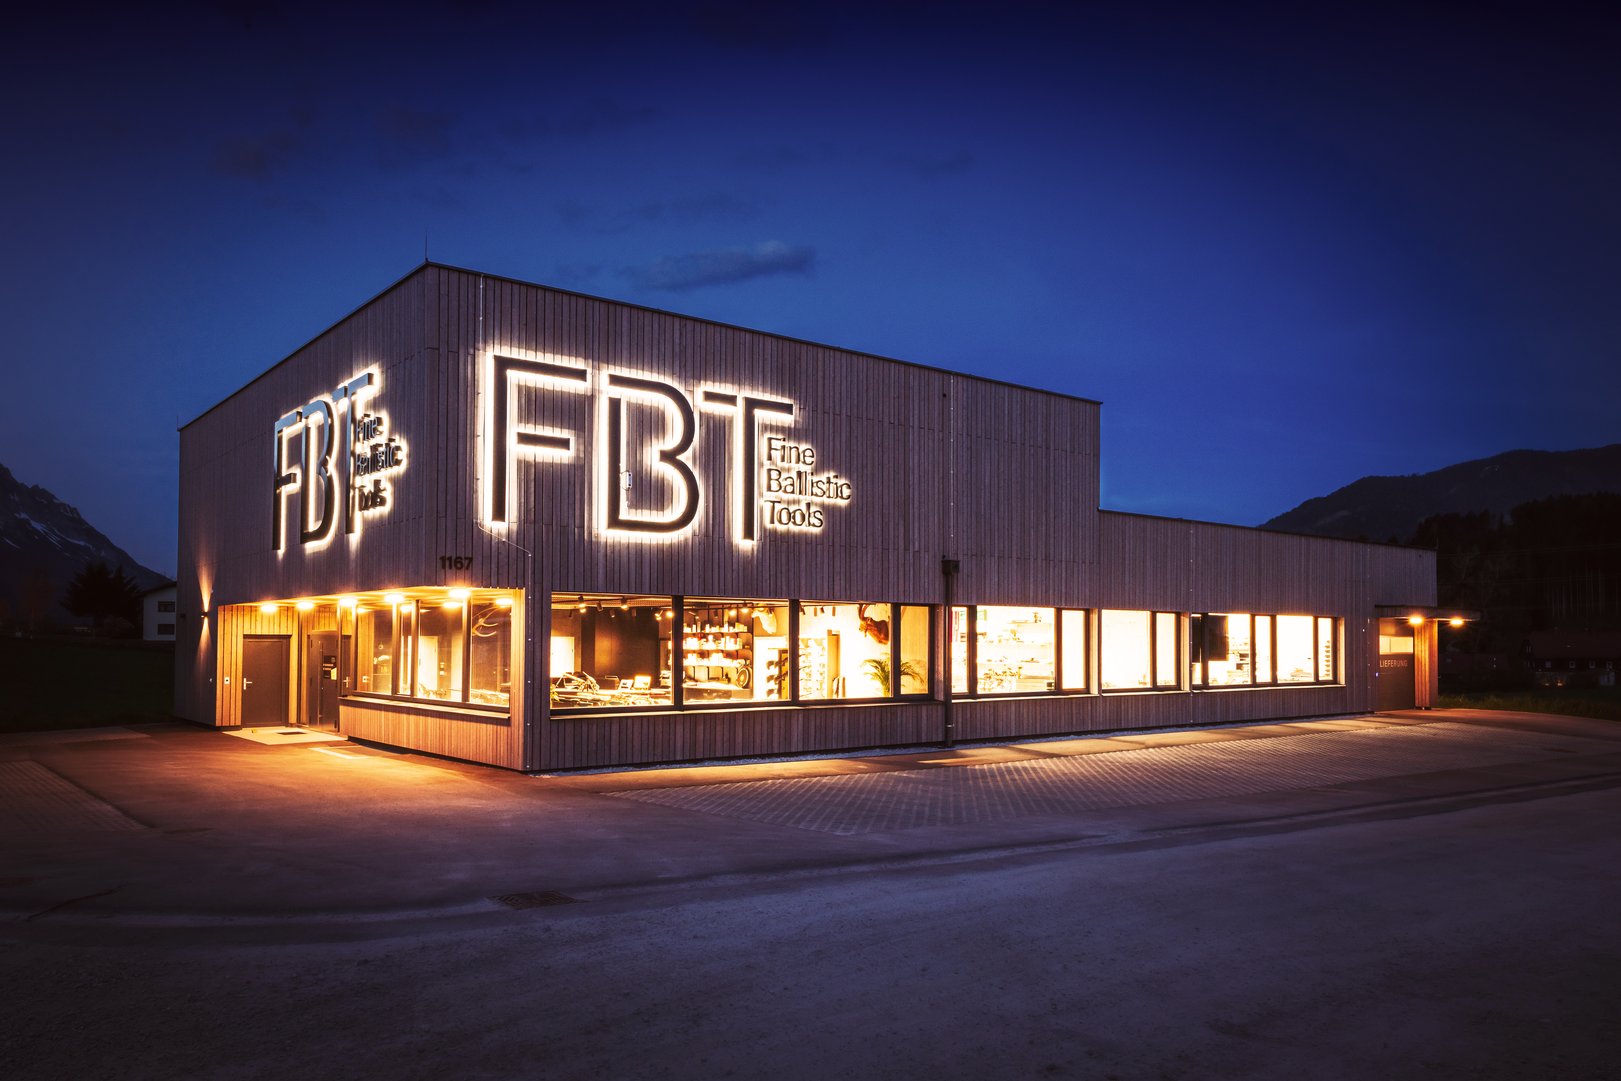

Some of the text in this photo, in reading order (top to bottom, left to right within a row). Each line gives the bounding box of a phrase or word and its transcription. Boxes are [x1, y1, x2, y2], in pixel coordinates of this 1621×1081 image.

[272, 373, 374, 550] FBT
[491, 355, 794, 541] FBT
[766, 437, 815, 466] Fine
[766, 468, 852, 500] Ballistic
[764, 500, 823, 528] Tools
[439, 555, 473, 570] 1167
